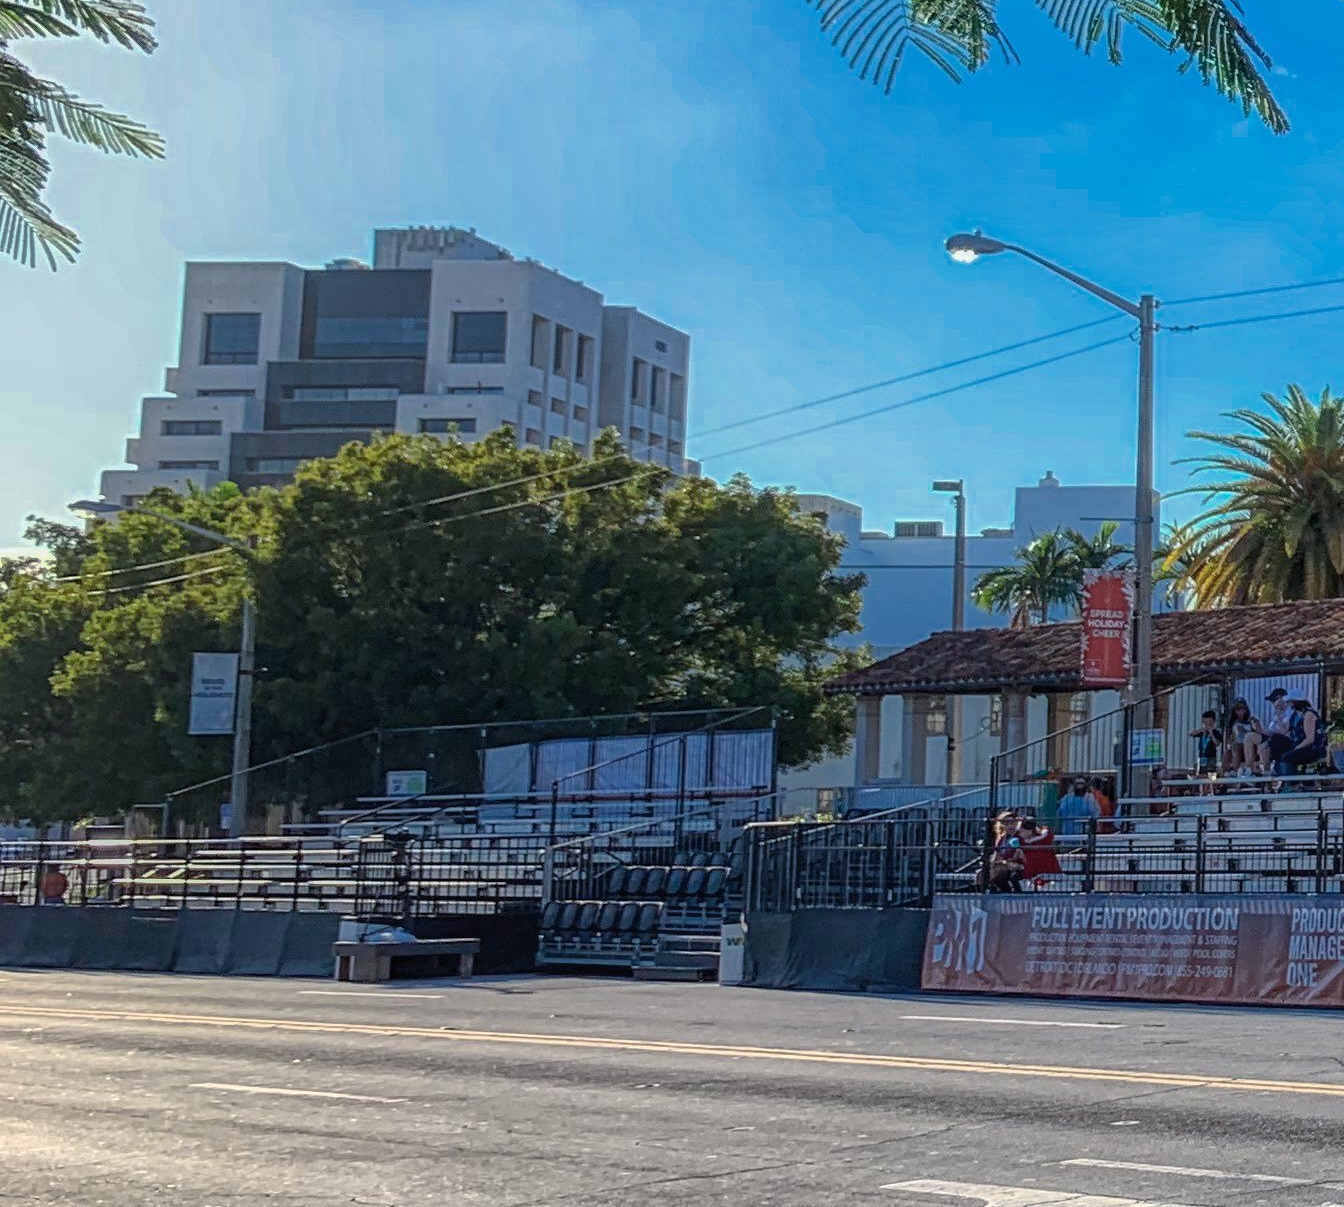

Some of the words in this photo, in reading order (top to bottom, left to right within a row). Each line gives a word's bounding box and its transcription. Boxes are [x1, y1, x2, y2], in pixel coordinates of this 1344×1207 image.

[1089, 610, 1124, 619] SPREAD
[1088, 619, 1125, 629] HOLIDAY
[1092, 629, 1120, 638] CHEER
[1031, 906, 1069, 929] FULL
[1071, 907, 1127, 930] EVENT
[1127, 907, 1239, 931] PRODUCTION
[1286, 961, 1319, 987] ONE
